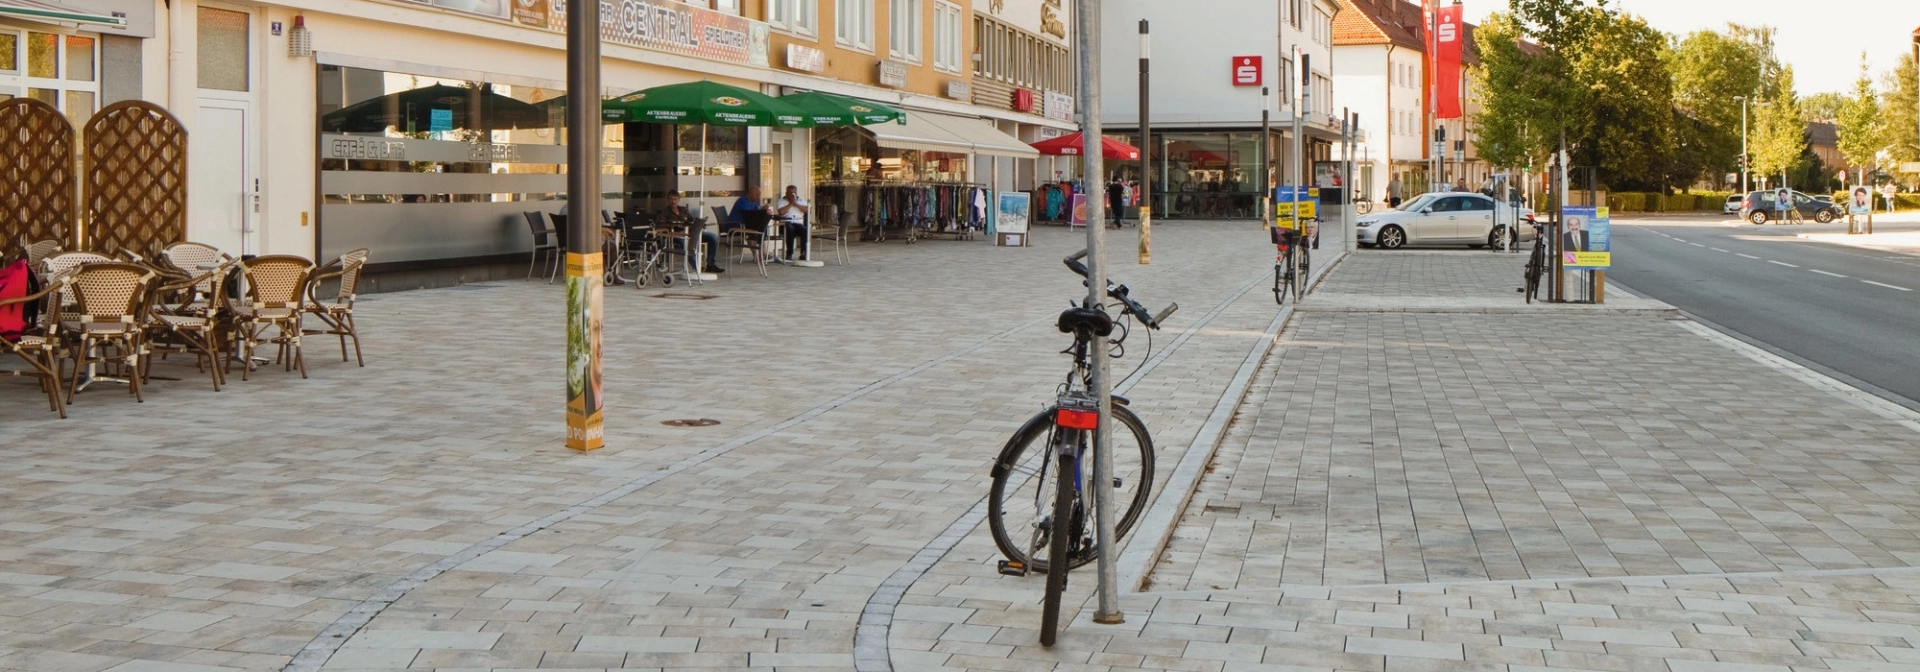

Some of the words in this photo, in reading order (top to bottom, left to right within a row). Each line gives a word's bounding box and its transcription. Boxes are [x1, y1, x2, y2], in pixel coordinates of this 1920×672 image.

[621, 0, 698, 47] CENTRAL
[705, 26, 746, 48] SPIELOTHEK
[332, 137, 365, 158] CAFÉ
[367, 141, 378, 158] &
[380, 142, 405, 160] BAR
[467, 143, 521, 163] CENTRAL
